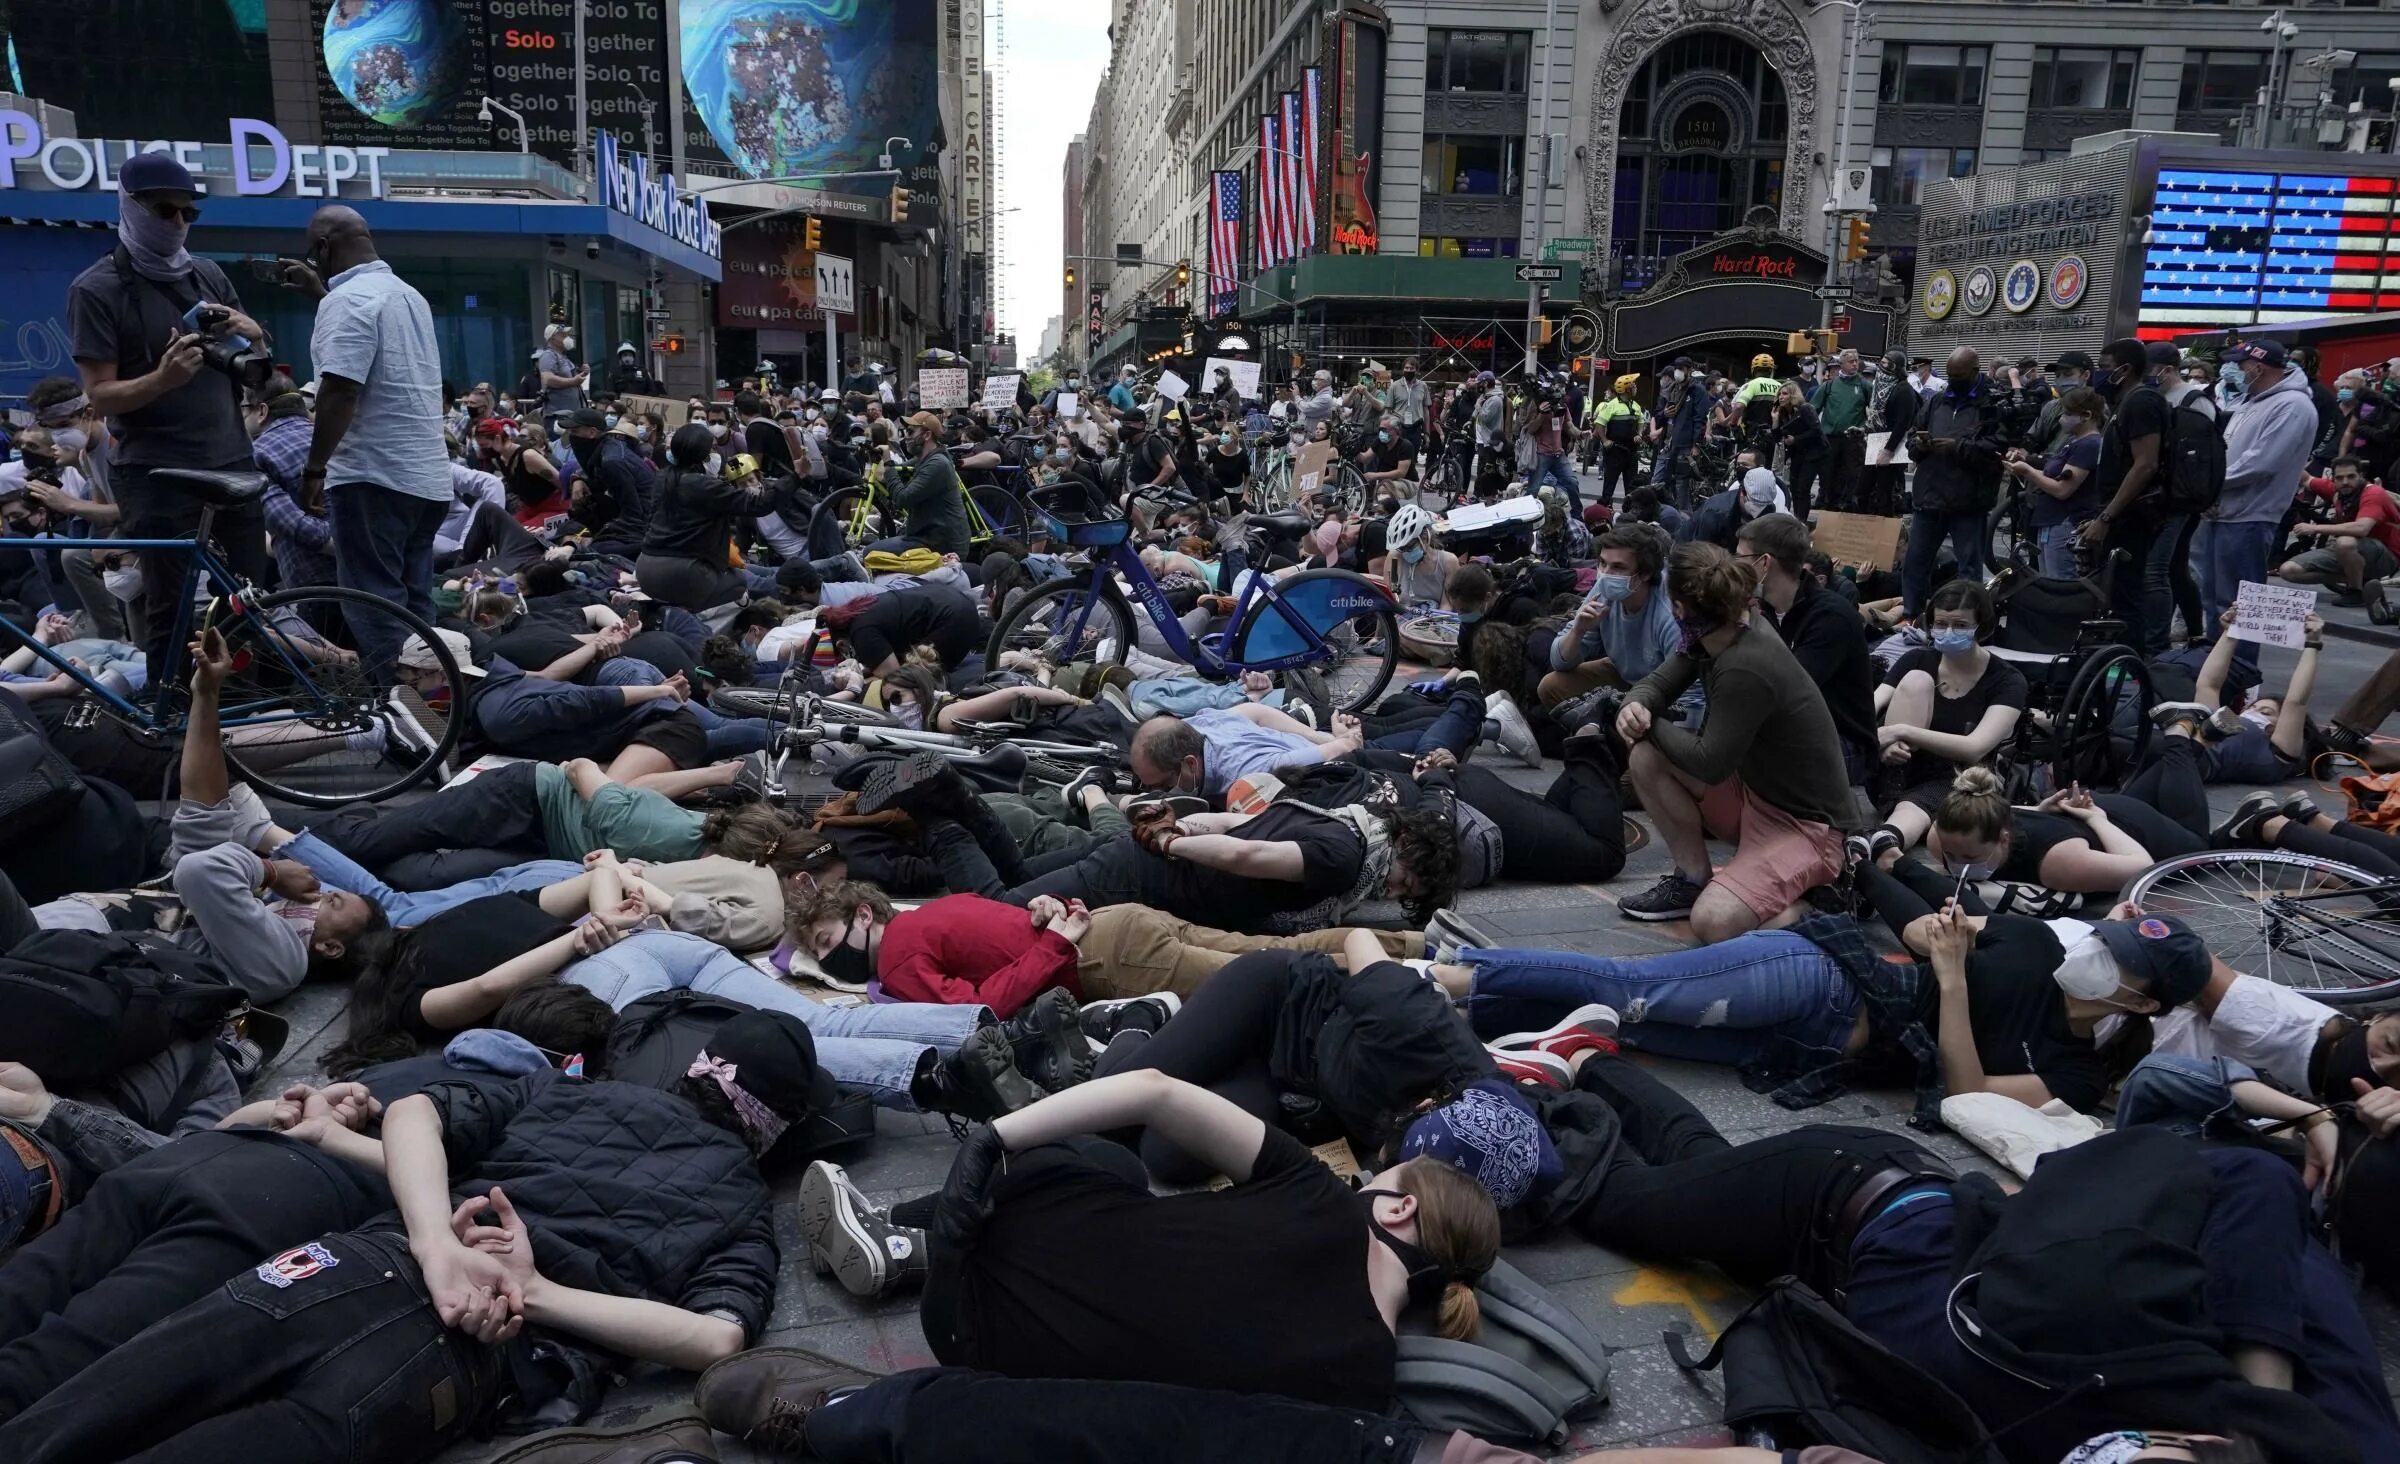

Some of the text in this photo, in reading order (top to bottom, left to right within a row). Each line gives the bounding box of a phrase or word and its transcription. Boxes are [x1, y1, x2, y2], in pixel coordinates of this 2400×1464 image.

[584, 0, 628, 18] Solo
[506, 29, 555, 48] Solo
[964, 0, 979, 98] HOTEL
[584, 64, 631, 81] Solo
[510, 93, 558, 110] Solo
[586, 126, 634, 144] Slo
[1688, 121, 1715, 132] 1501
[332, 133, 353, 141] Solo
[395, 134, 414, 142] Solo
[456, 136, 476, 144] Solo
[1679, 138, 1722, 149] BROADWAY
[0, 109, 389, 198] POLIE DEPT
[965, 111, 980, 238] CARTER
[602, 128, 721, 260] NEW YORK POLICE DEPT
[908, 189, 939, 205] Solo
[794, 195, 867, 212] THOMSON REUTERS
[1957, 203, 2023, 236] ARMED
[2028, 190, 2113, 228] FORCES
[1335, 224, 1376, 250] Hard Rock
[1555, 239, 1591, 250] Broadway
[1927, 222, 2098, 263] RECRUITING STATION
[1713, 255, 1797, 281] Hard Rock
[818, 296, 829, 306] ONLY
[830, 298, 840, 308] ONLY
[731, 304, 791, 322] europa
[1226, 321, 1242, 331] 1501
[938, 378, 966, 386] SILENT
[1760, 383, 1779, 393] NYP
[934, 389, 961, 398] MATTER
[984, 389, 1000, 397] BLACK
[625, 397, 670, 422] BLACK
[2287, 589, 2312, 600] DEAD
[2285, 607, 2306, 616] EYES
[1494, 838, 1503, 876] didas
[2224, 855, 2294, 864] WEINMANN
[265, 1273, 288, 1287] CLUB
